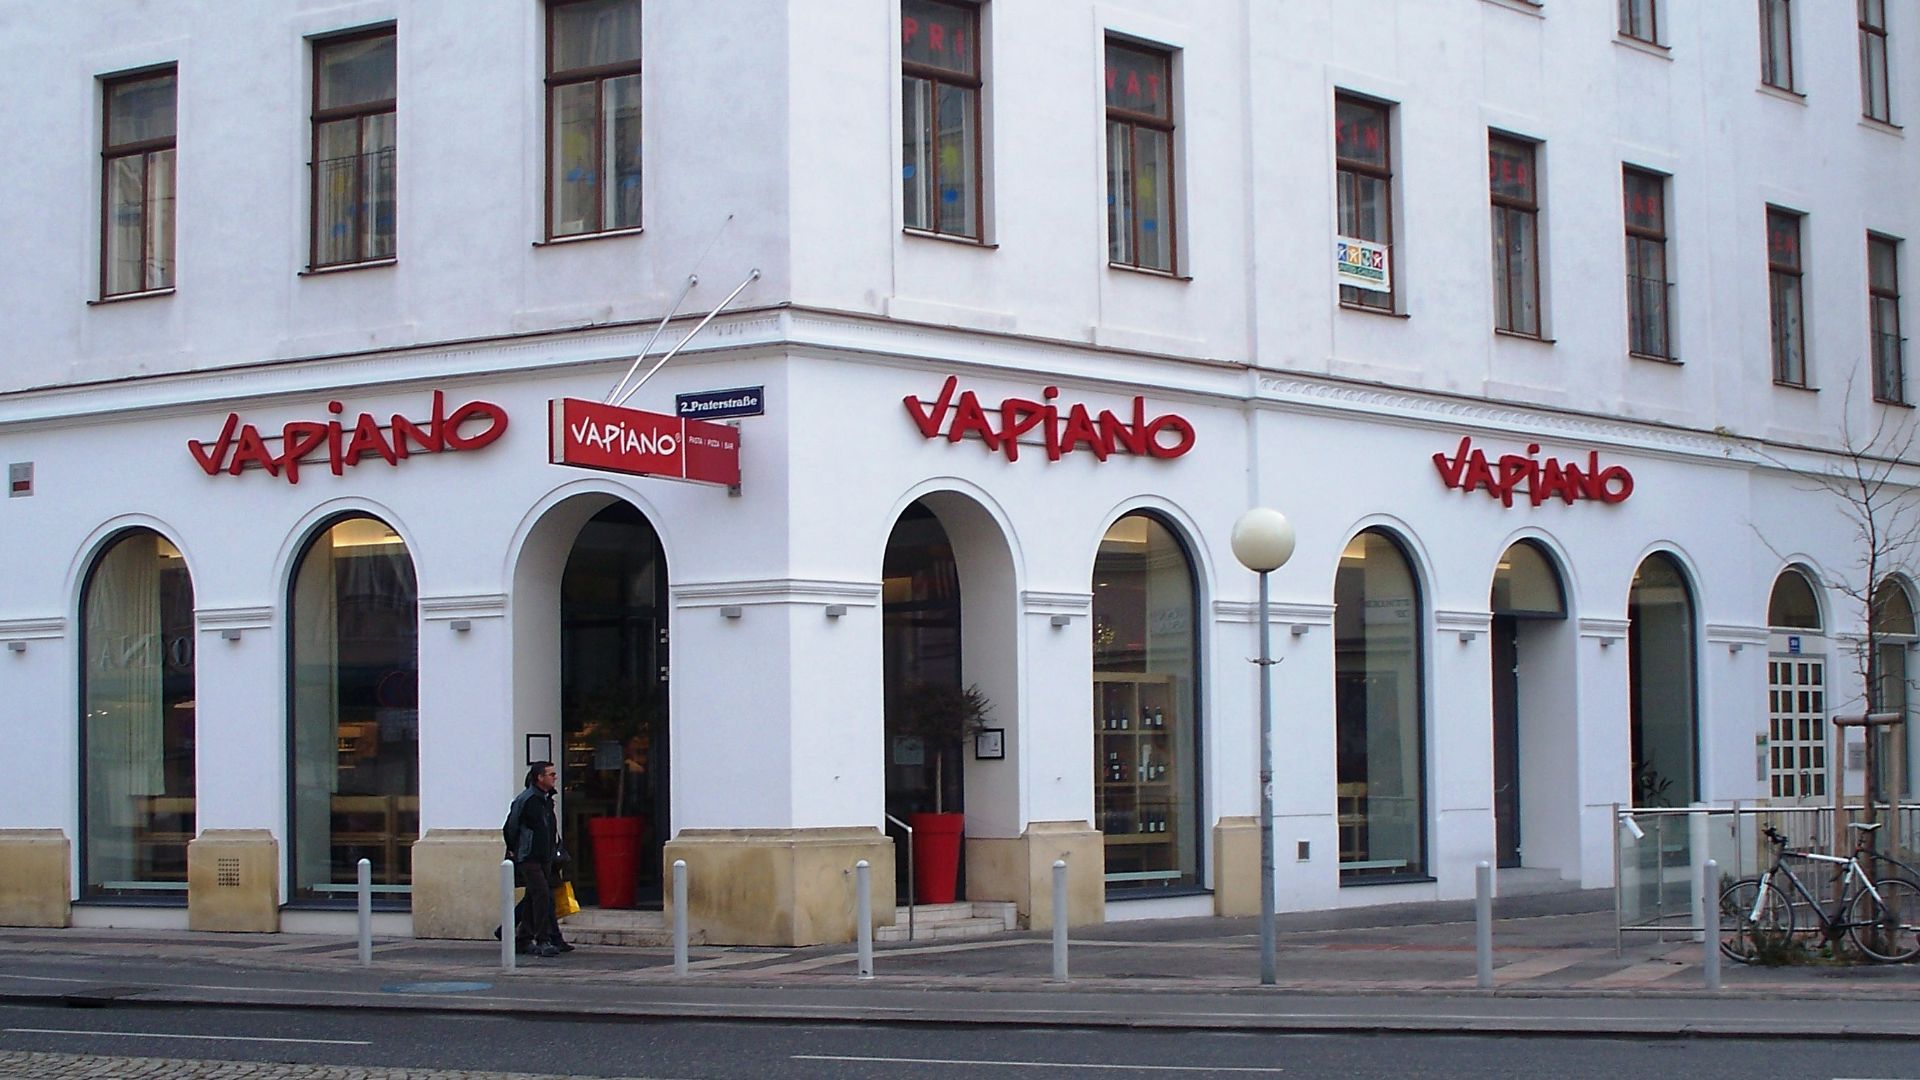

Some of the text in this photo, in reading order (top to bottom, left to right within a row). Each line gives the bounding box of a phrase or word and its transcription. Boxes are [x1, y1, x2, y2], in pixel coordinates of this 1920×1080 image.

[902, 16, 964, 57] PRI
[187, 389, 509, 484] VAPIANO
[571, 416, 676, 455] VAPIANO
[903, 375, 1196, 462] VAPIANO
[1432, 436, 1634, 508] VAPIANO
